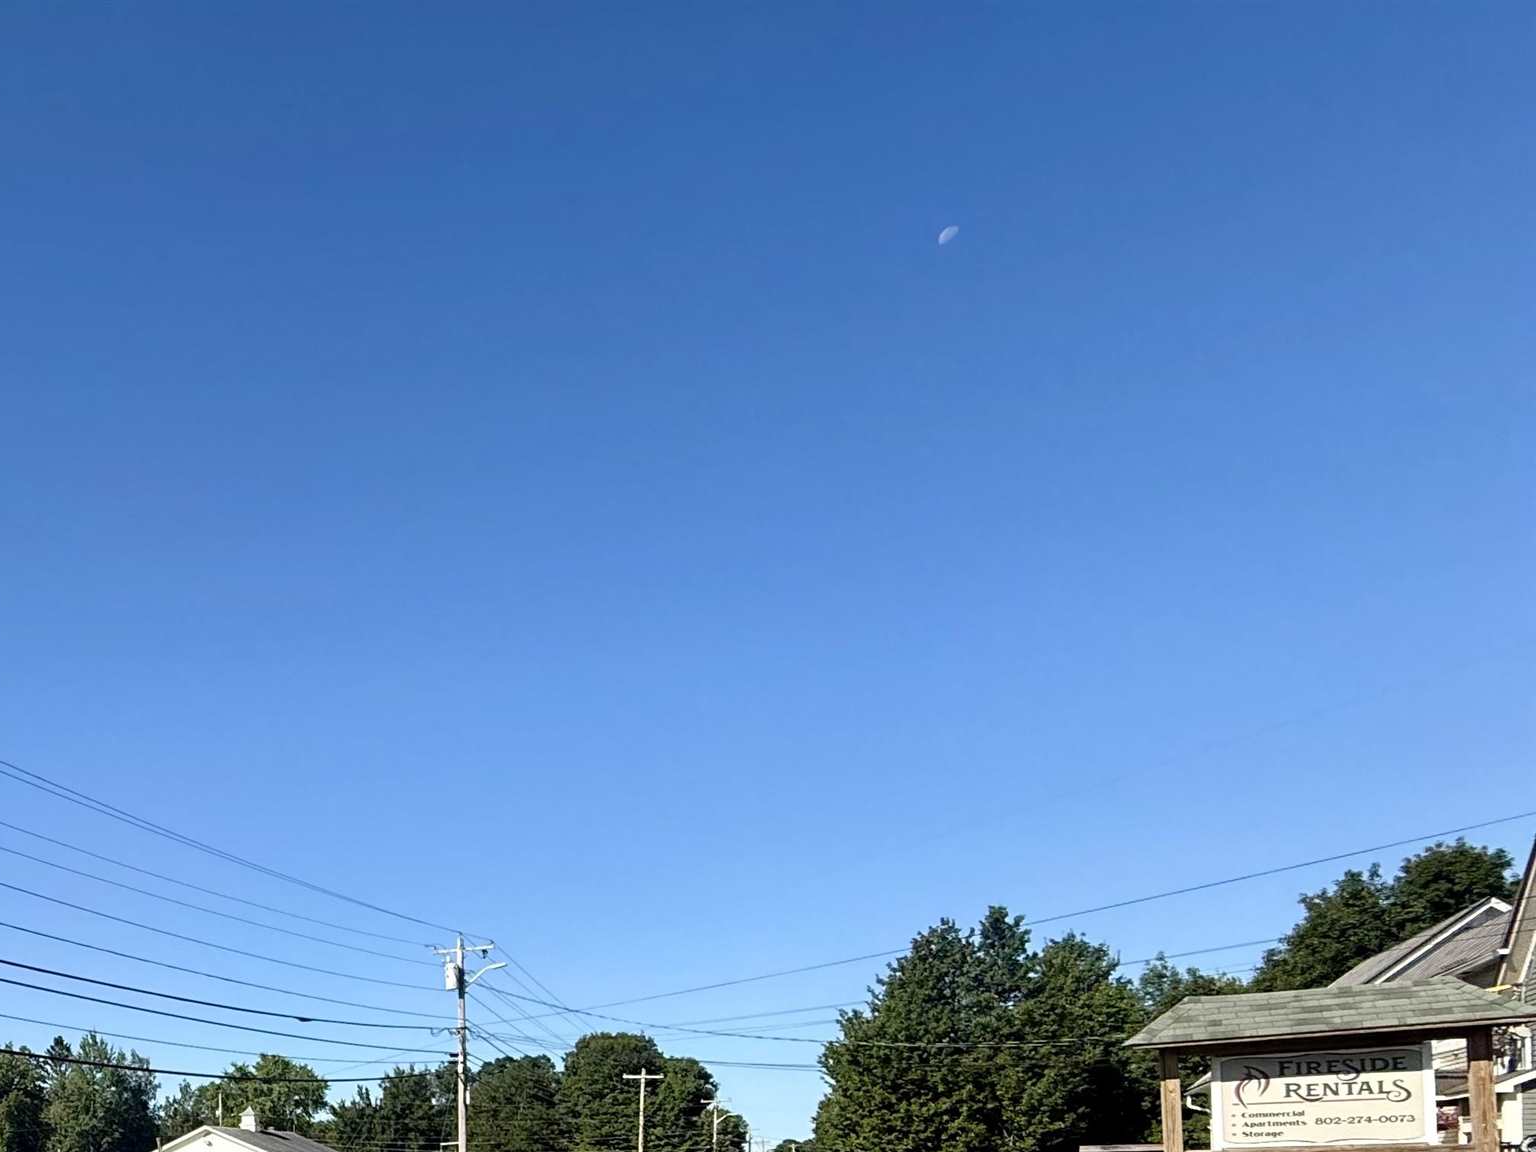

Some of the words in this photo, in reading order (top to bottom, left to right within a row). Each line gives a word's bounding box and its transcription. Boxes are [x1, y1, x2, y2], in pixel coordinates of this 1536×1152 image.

[1277, 1056, 1407, 1081] FIRESIDE
[1283, 1079, 1413, 1103] RENTALS
[1241, 1110, 1306, 1119] Commercial
[1314, 1114, 1416, 1126] 802-274-0073
[1241, 1119, 1308, 1129] Apartments
[1241, 1130, 1285, 1139] Storage
